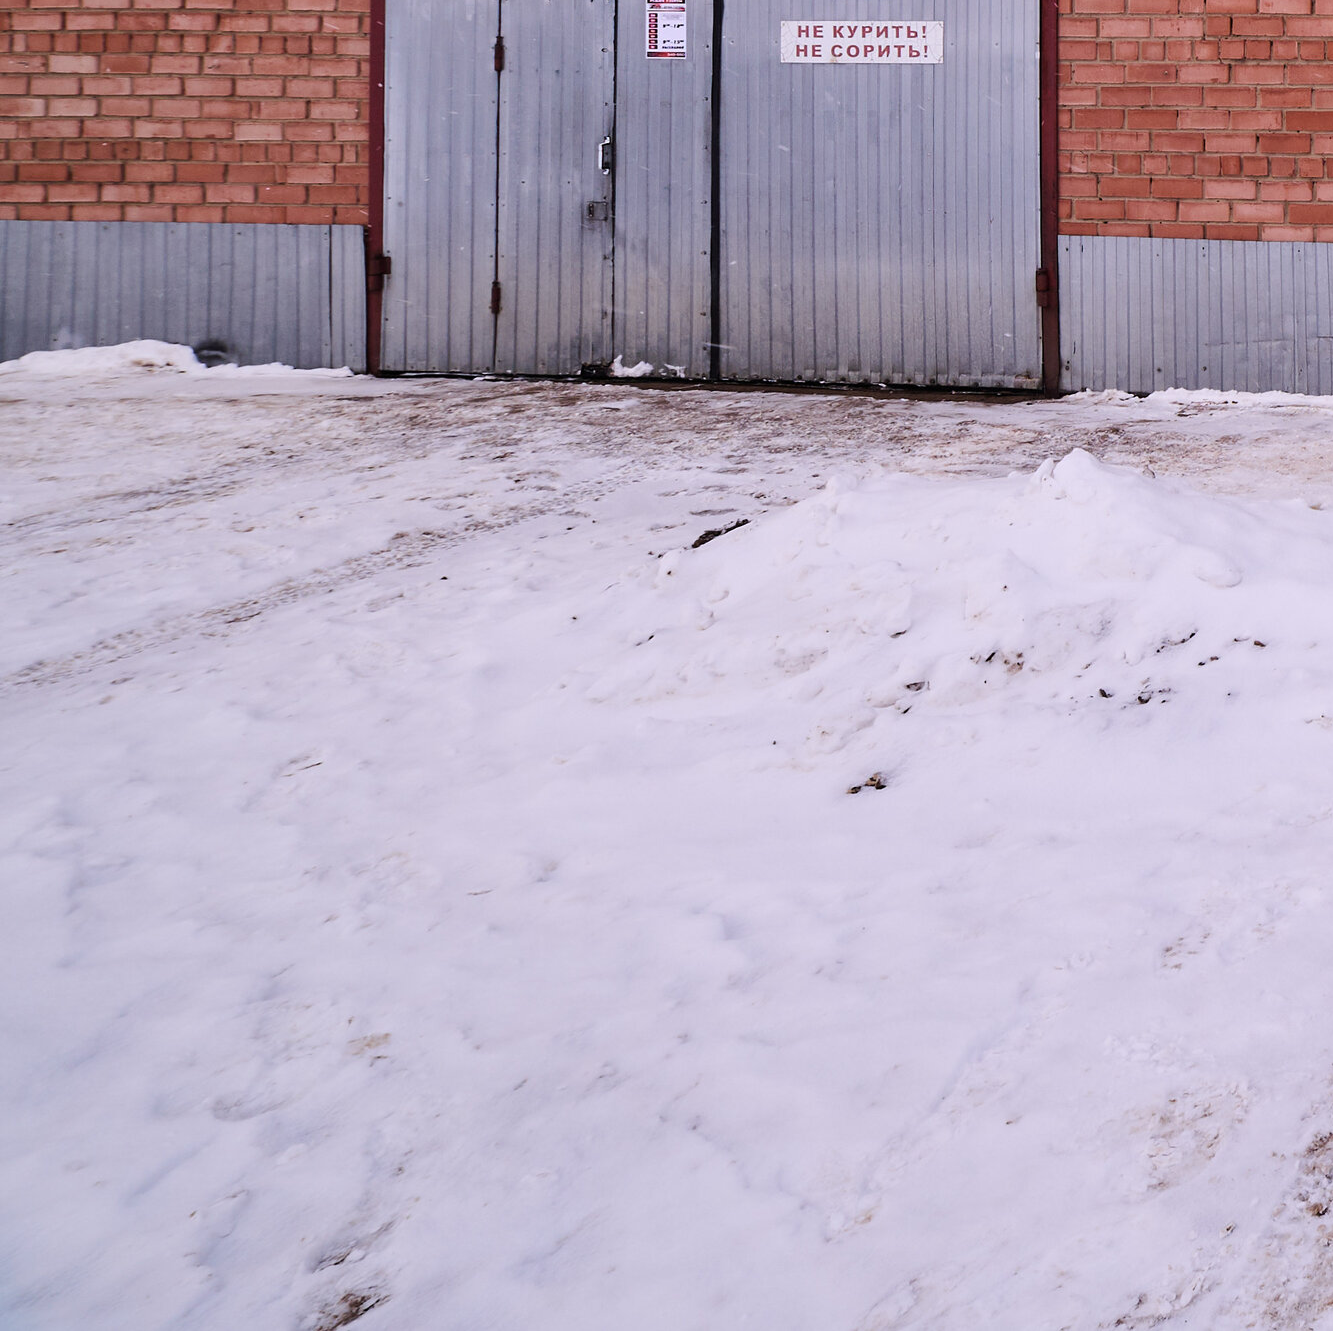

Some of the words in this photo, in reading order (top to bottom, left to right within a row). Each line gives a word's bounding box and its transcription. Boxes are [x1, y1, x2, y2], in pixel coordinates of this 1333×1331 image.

[797, 25, 824, 39] НЕ
[832, 25, 927, 39] КУРИТЬ!
[795, 44, 823, 58] НЕ
[830, 44, 928, 58] СОРИТЬ!
